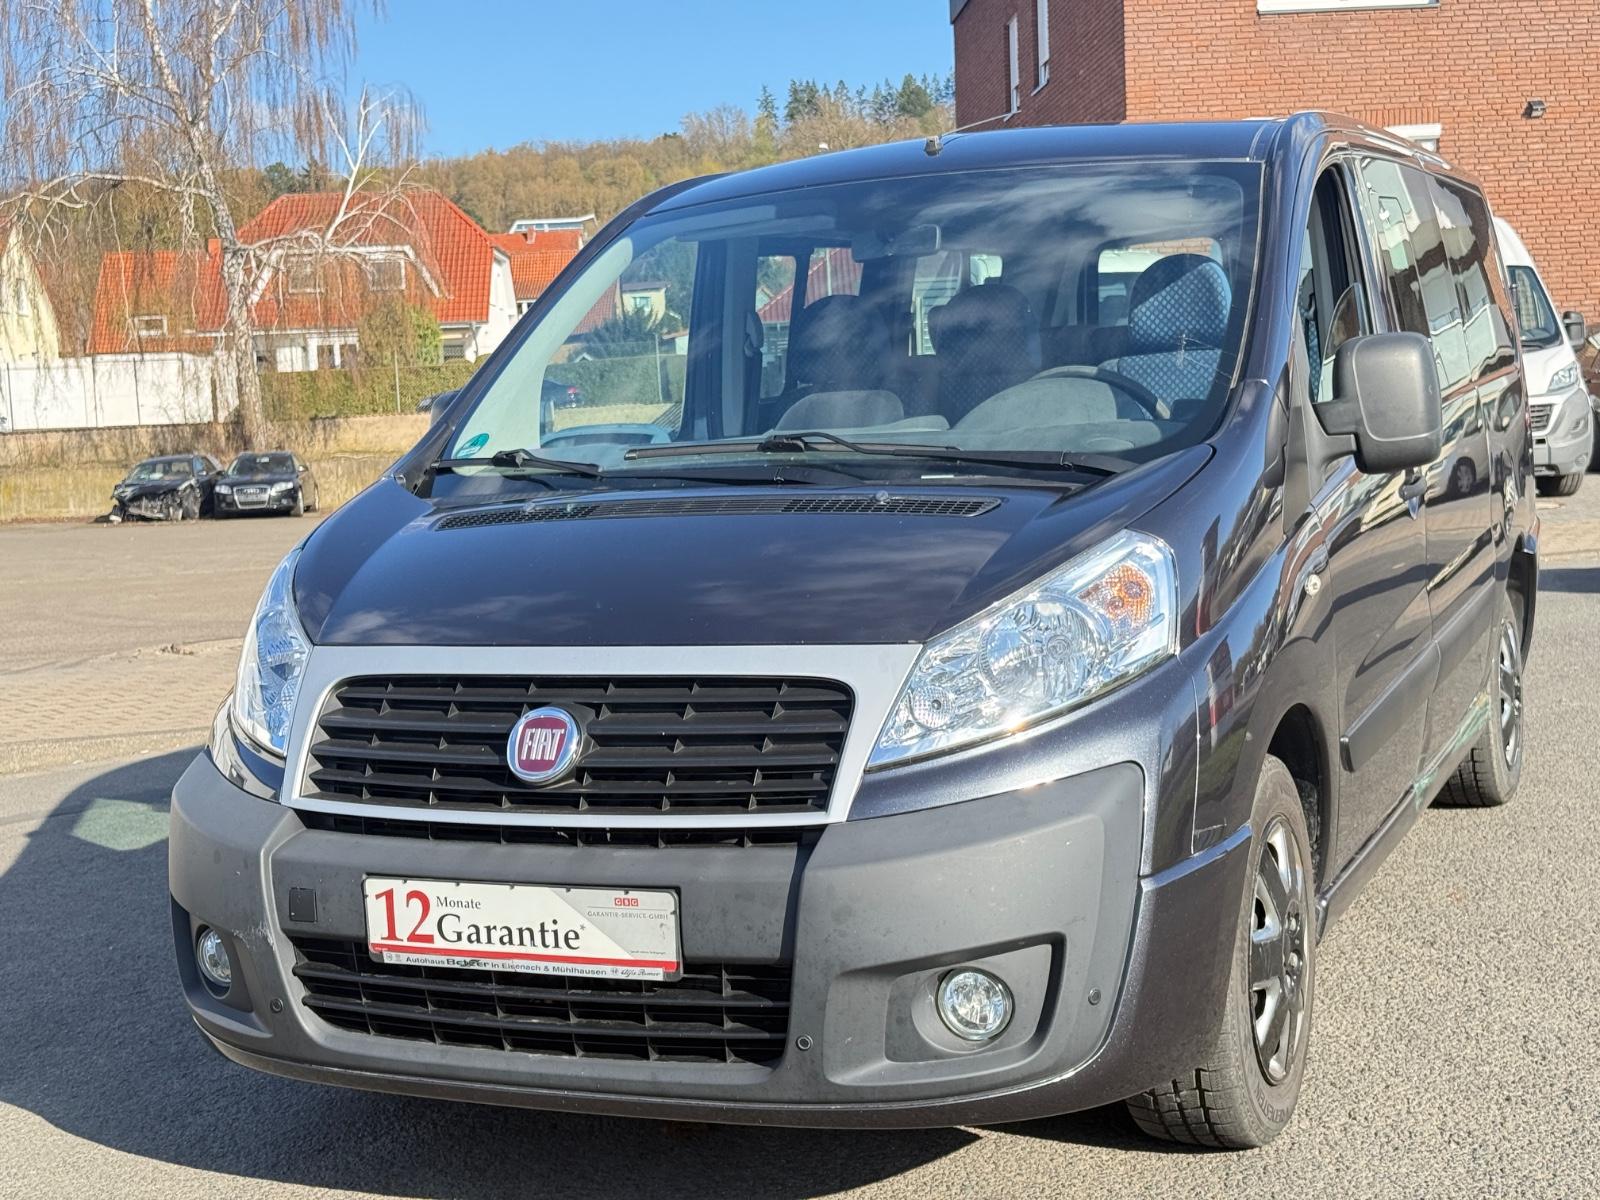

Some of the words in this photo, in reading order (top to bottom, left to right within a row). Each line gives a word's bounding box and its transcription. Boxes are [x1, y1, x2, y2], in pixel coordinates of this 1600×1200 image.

[521, 728, 565, 761] FIAT
[375, 887, 434, 944] 12
[436, 896, 481, 910] Monate
[406, 956, 446, 966] Autohaus
[502, 962, 541, 972] Eisenach
[552, 965, 607, 976] Mühlhausen
